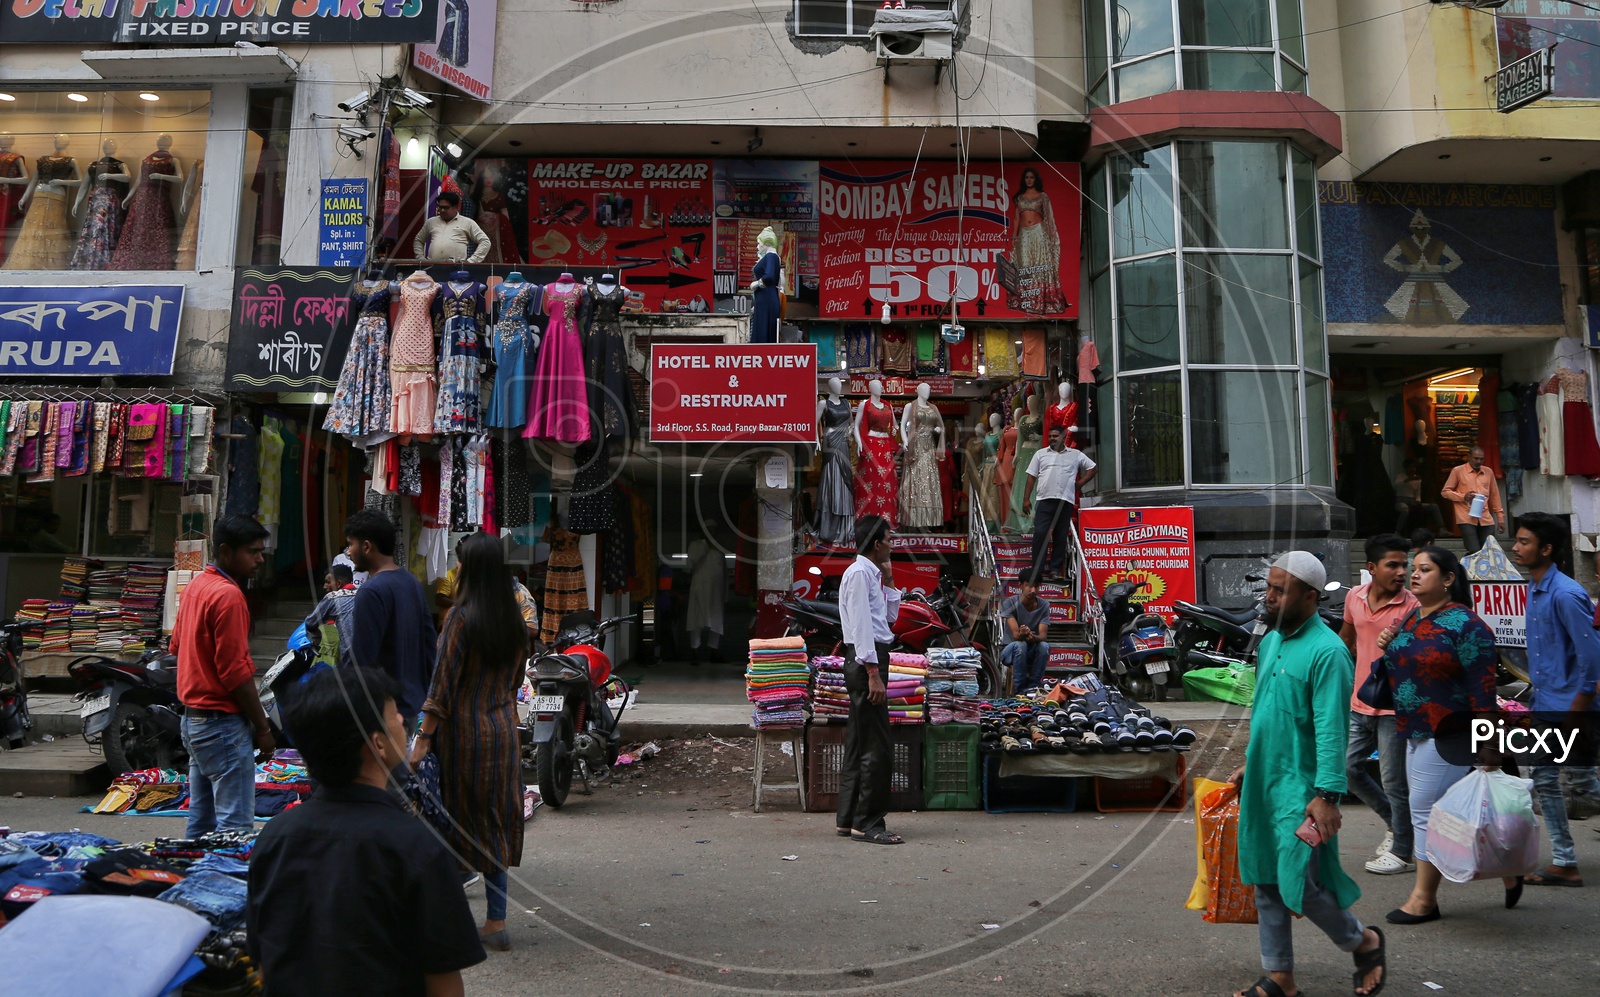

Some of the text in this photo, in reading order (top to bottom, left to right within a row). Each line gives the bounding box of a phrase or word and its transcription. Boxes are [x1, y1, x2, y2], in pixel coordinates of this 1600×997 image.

[1557, 0, 1571, 15] OFF
[122, 22, 311, 36] FIXED PRICE
[418, 51, 490, 99] 50% DISCOUNT
[1498, 53, 1541, 93] BOMBAY
[1498, 76, 1541, 107] SAREES
[532, 163, 709, 180] MAKE-UP BAZAR
[538, 180, 701, 189] WHOLESALE PRICE
[820, 174, 1010, 220] BOMBAY SAREES
[1444, 183, 1554, 208] ARCADE
[324, 197, 363, 210] KAMAL
[323, 212, 363, 226] TAILORS
[330, 229, 343, 240] Spl.
[344, 229, 351, 238] in
[876, 229, 892, 242] The
[895, 229, 927, 245] Unique
[929, 229, 961, 245] Design
[962, 229, 974, 245] of
[321, 241, 364, 252] PANT, SHIRT
[824, 251, 861, 268] Fashion
[865, 247, 1006, 263] DISCOUNT
[714, 274, 736, 295] WAY
[824, 273, 865, 291] Friendly
[869, 265, 1000, 302] 50%
[239, 283, 286, 329] দিল্লী
[733, 296, 747, 314] TO
[826, 298, 850, 314] Price
[920, 304, 961, 316] FLOOR
[0, 340, 121, 366] RUPA
[658, 355, 810, 368] HOTEL RIVER VIEW
[728, 374, 739, 388] &
[680, 394, 788, 408] RESTRURANT
[657, 423, 811, 434] 3rd Floor, S.S. Road, Fancy Bazar-781001
[1084, 525, 1188, 545] BOMBAY READYMADE
[997, 547, 1019, 556] BOMBAY
[1084, 547, 1190, 558] SPECIAL LEHENGA CHUNNI, KURTI
[1110, 560, 1114, 568] &
[1156, 560, 1189, 569] CHURIDAR
[1472, 584, 1528, 616] PARKIN
[1499, 618, 1513, 626] FOR
[1495, 627, 1527, 637] RIVER VIE
[1049, 652, 1083, 662] READYMADE
